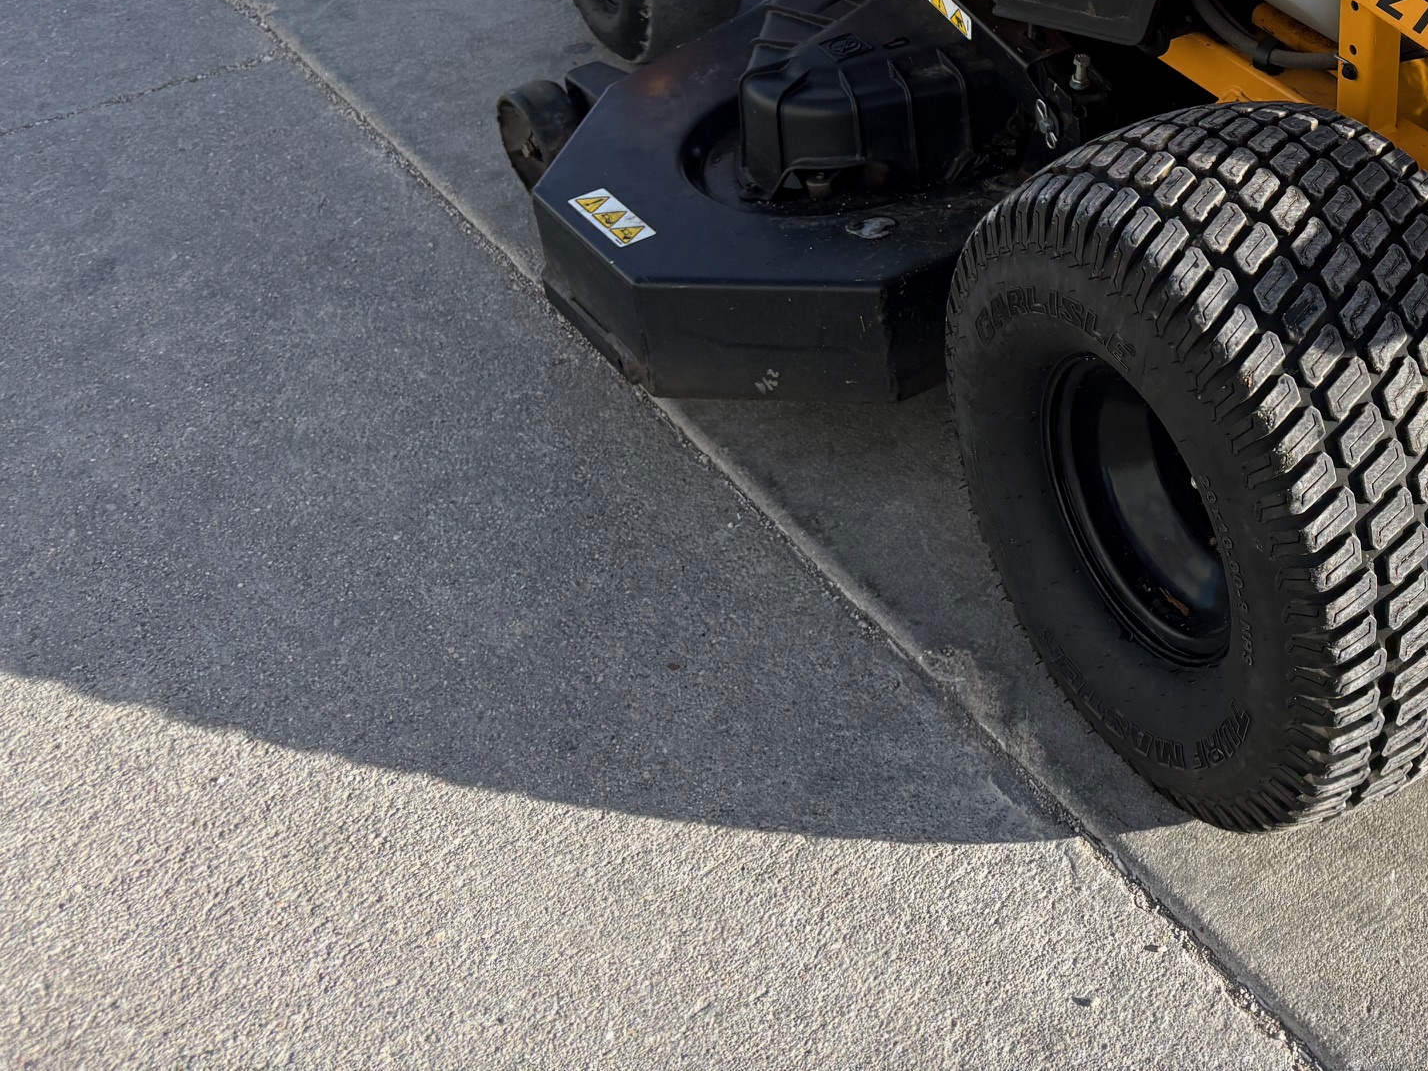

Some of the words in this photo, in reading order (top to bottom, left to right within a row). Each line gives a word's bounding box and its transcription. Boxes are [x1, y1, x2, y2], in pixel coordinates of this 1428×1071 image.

[974, 284, 1137, 372] CARLISLE
[1037, 626, 1187, 771] MASTER
[1192, 698, 1252, 770] TURF
